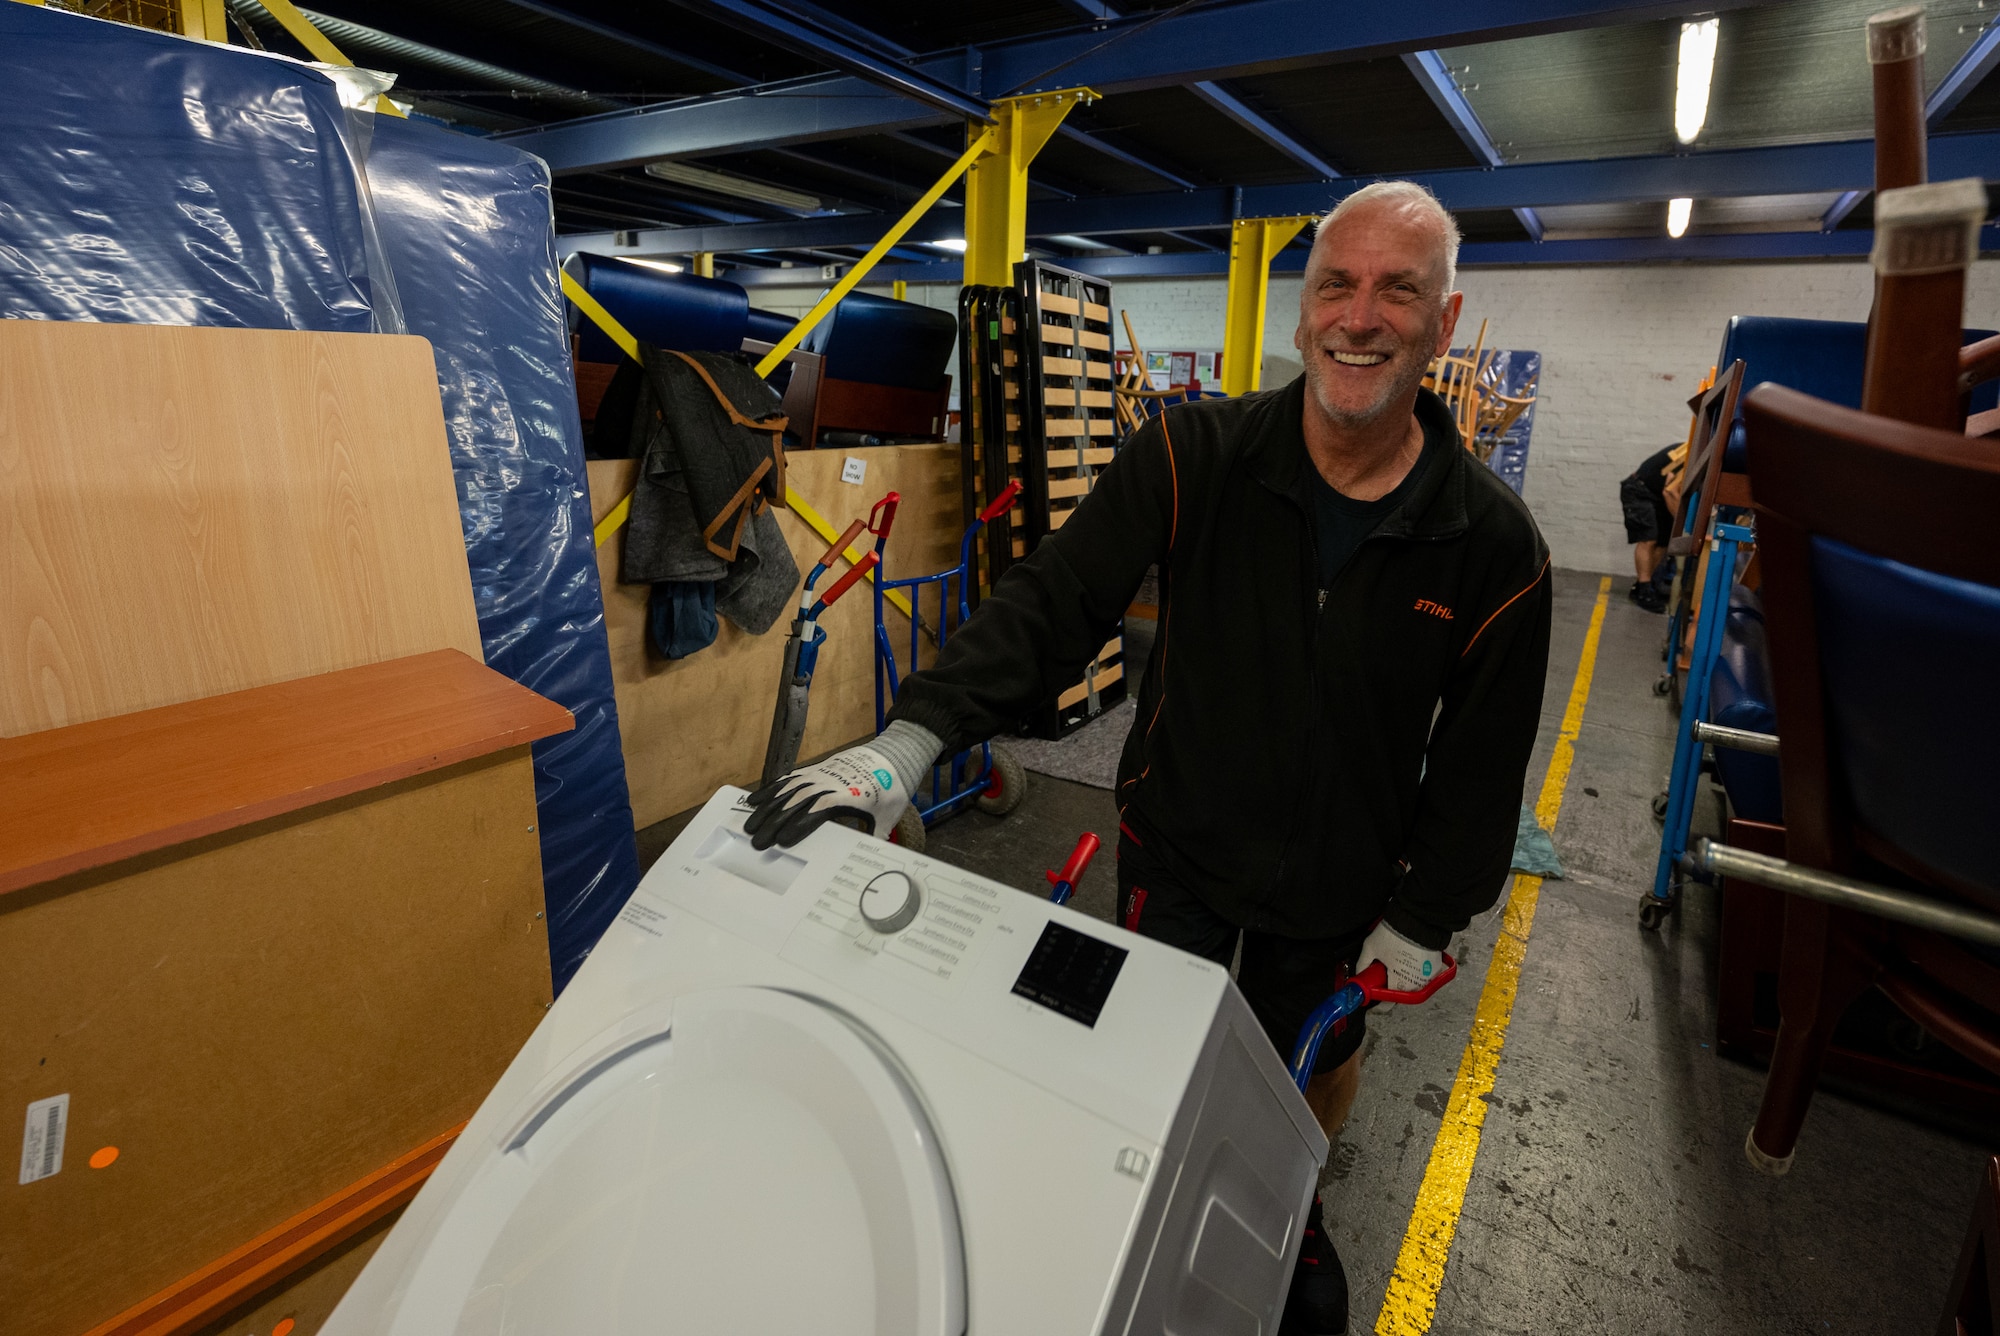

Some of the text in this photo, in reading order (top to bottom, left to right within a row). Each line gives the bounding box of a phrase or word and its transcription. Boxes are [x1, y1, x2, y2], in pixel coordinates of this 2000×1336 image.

[1413, 599, 1454, 620] STIHL
[961, 878, 979, 889] Cottons
[990, 889, 998, 898] Dry
[963, 894, 981, 905] Cottons
[933, 898, 951, 909] Cottons
[974, 914, 982, 924] Dry
[935, 913, 953, 925] Cottons
[966, 927, 975, 936] Dry
[958, 940, 967, 951] Dry
[950, 954, 959, 965] Dry
